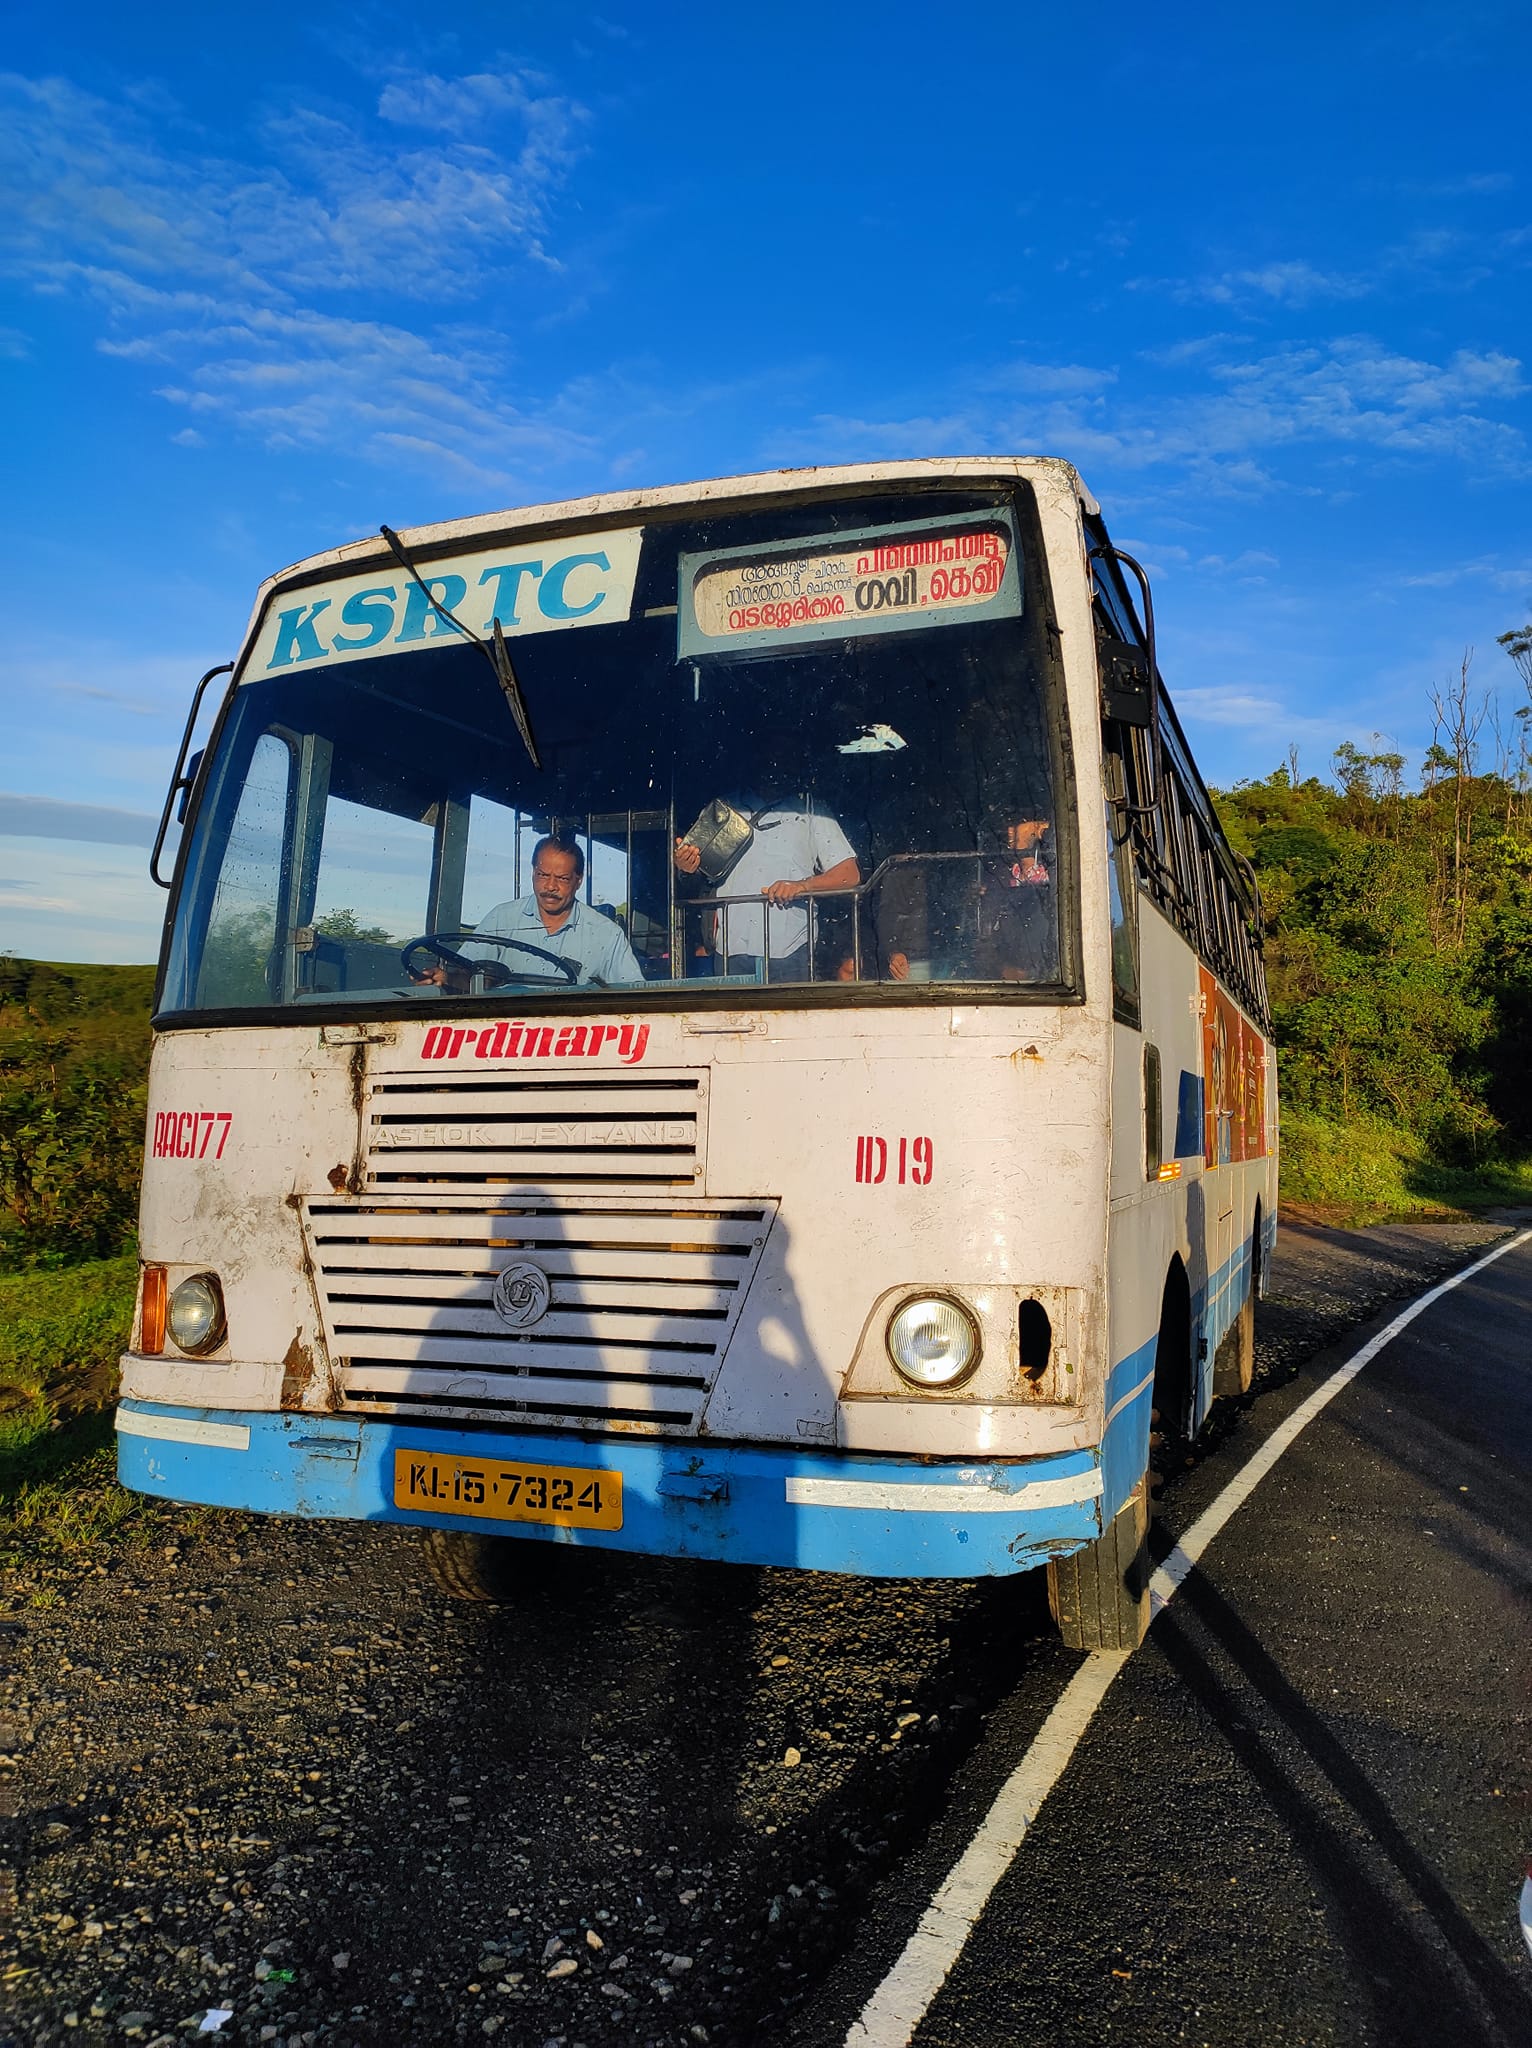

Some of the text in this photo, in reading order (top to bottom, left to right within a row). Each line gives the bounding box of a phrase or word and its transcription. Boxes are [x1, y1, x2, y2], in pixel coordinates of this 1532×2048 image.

[266, 550, 612, 670] KSRTC
[420, 1020, 651, 1065] Ordinary
[368, 1121, 696, 1146] ASHOK LEYLAND
